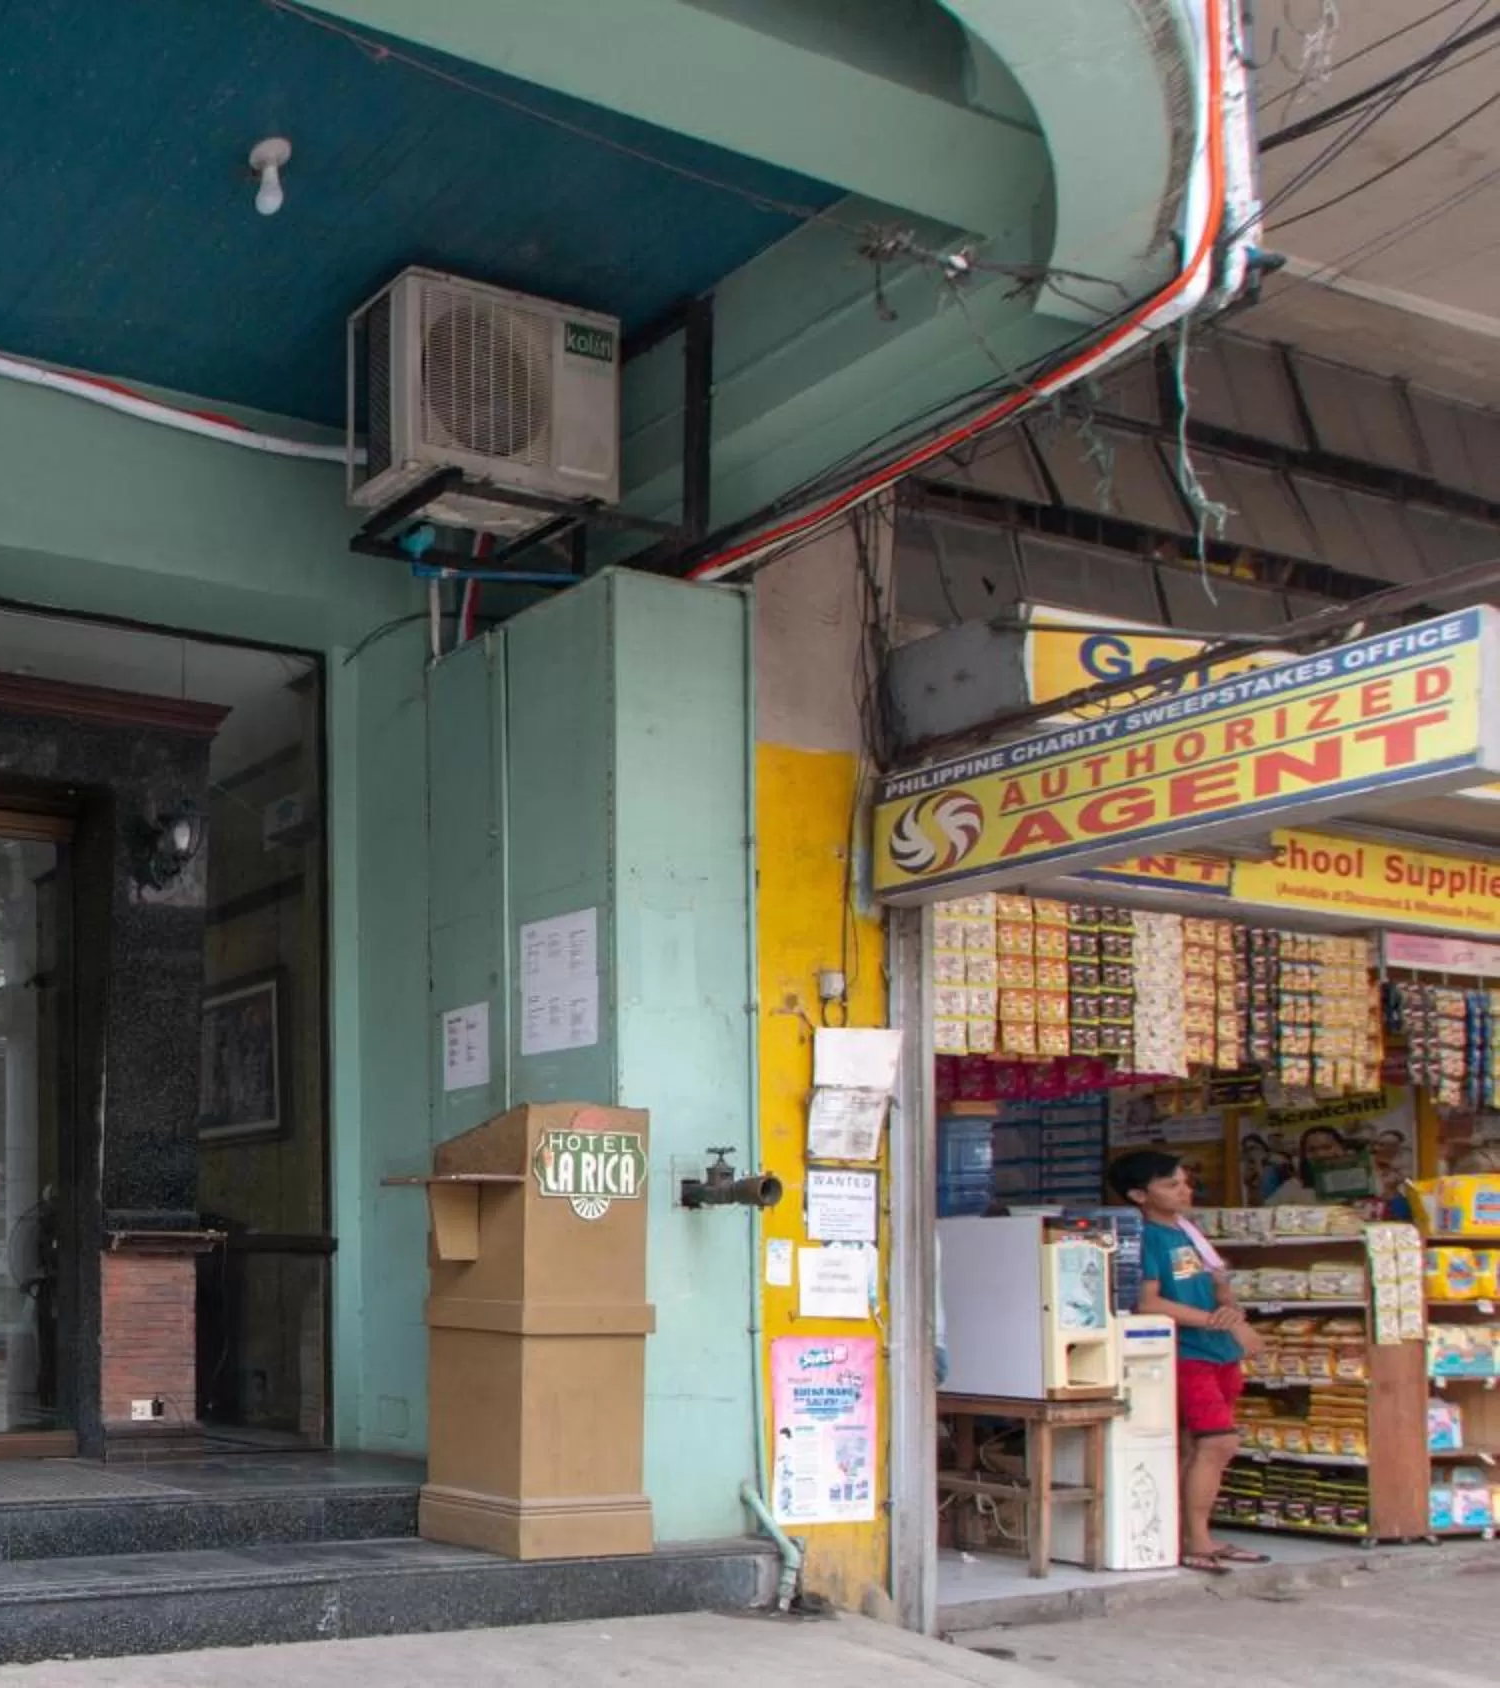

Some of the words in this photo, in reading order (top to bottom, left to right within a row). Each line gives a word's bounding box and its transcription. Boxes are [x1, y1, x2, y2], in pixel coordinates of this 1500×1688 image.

[884, 753, 1005, 799] PHILIPPINE
[1011, 719, 1119, 763] CHARITY
[1125, 658, 1334, 730] SWEEPSTAKES
[1343, 620, 1464, 668] OFFICE
[1000, 665, 1452, 810] AUTHORIZED
[998, 709, 1449, 857] AGENT
[1271, 838, 1364, 878] chool
[548, 1133, 633, 1153] HOTEL
[543, 1151, 575, 1192] LA
[581, 1152, 636, 1194] RICA
[813, 1174, 872, 1189] WANTED
